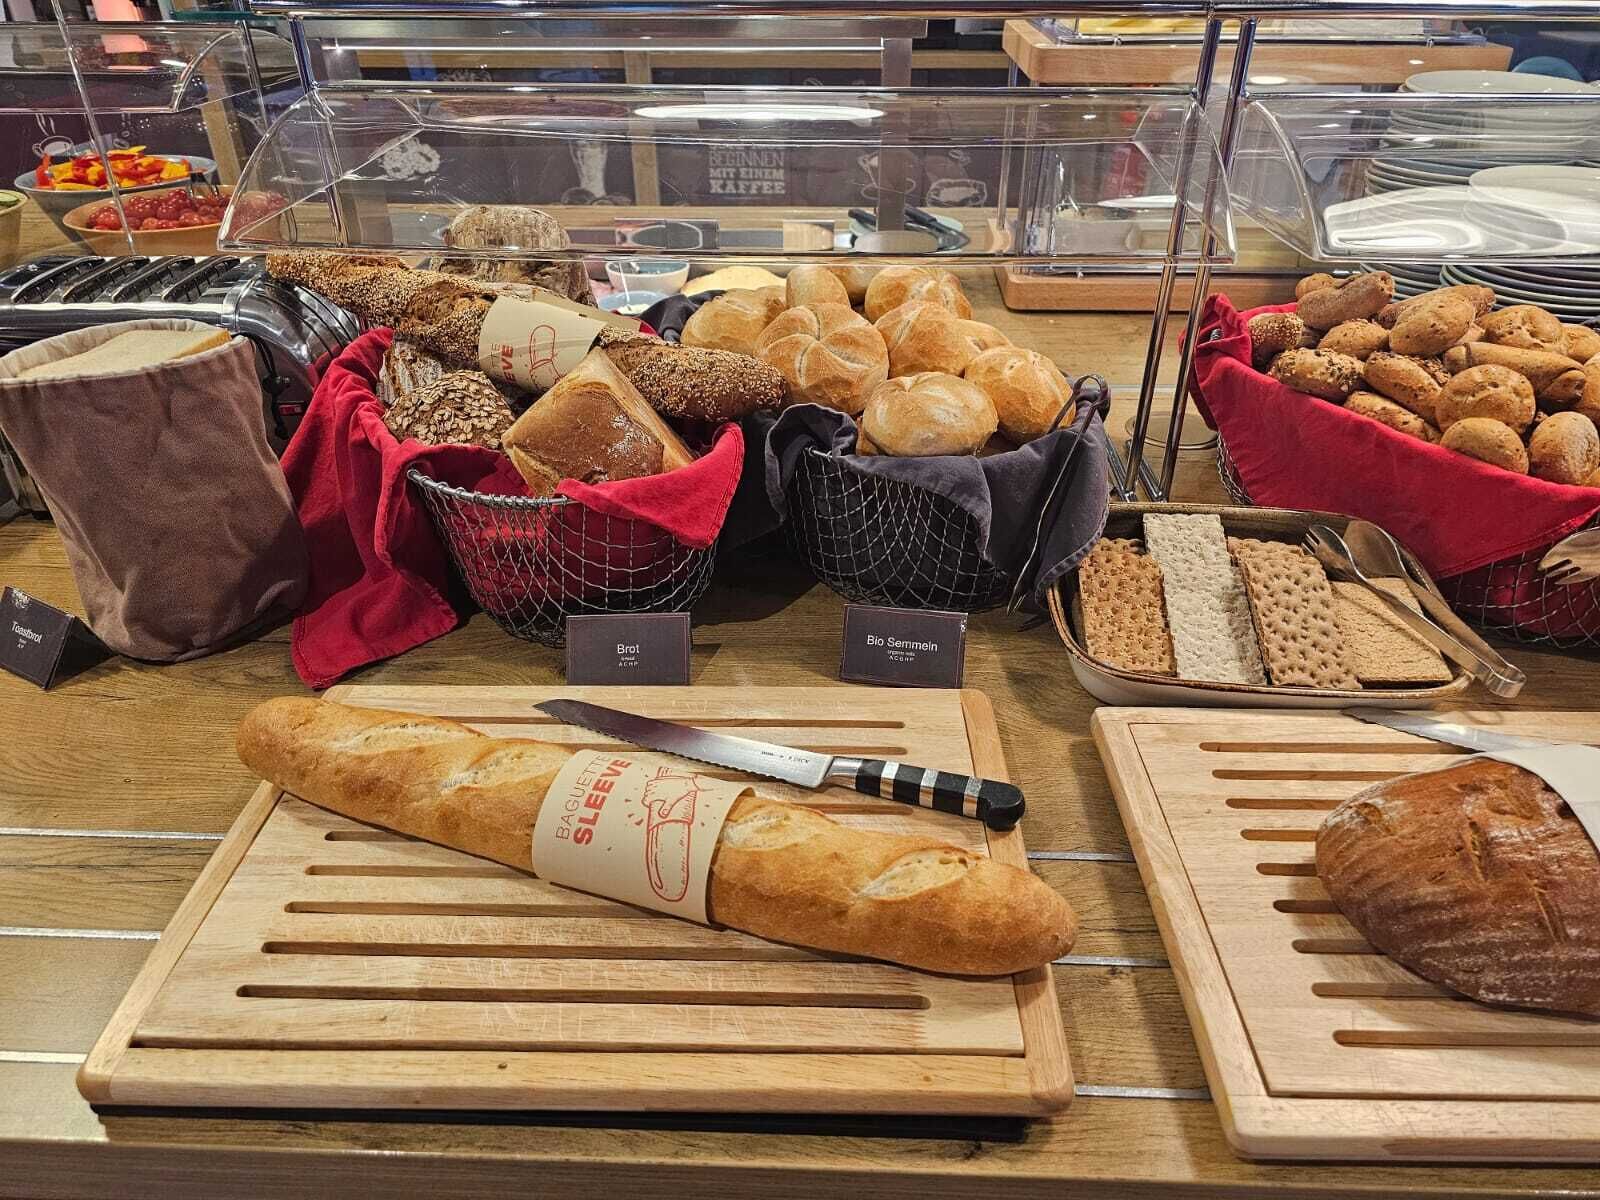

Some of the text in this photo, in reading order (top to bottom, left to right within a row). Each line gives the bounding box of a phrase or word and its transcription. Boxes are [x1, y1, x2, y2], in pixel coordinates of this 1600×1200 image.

[709, 167, 784, 180] MIT EINEM
[709, 180, 785, 194] KAFFEE
[501, 344, 516, 385] EVE
[11, 620, 43, 644] Toastbrot
[617, 643, 640, 654] Brot
[866, 634, 938, 652] Bio Semmeln
[555, 753, 612, 840] BAGUETTE
[573, 758, 633, 845] SLEEVE
